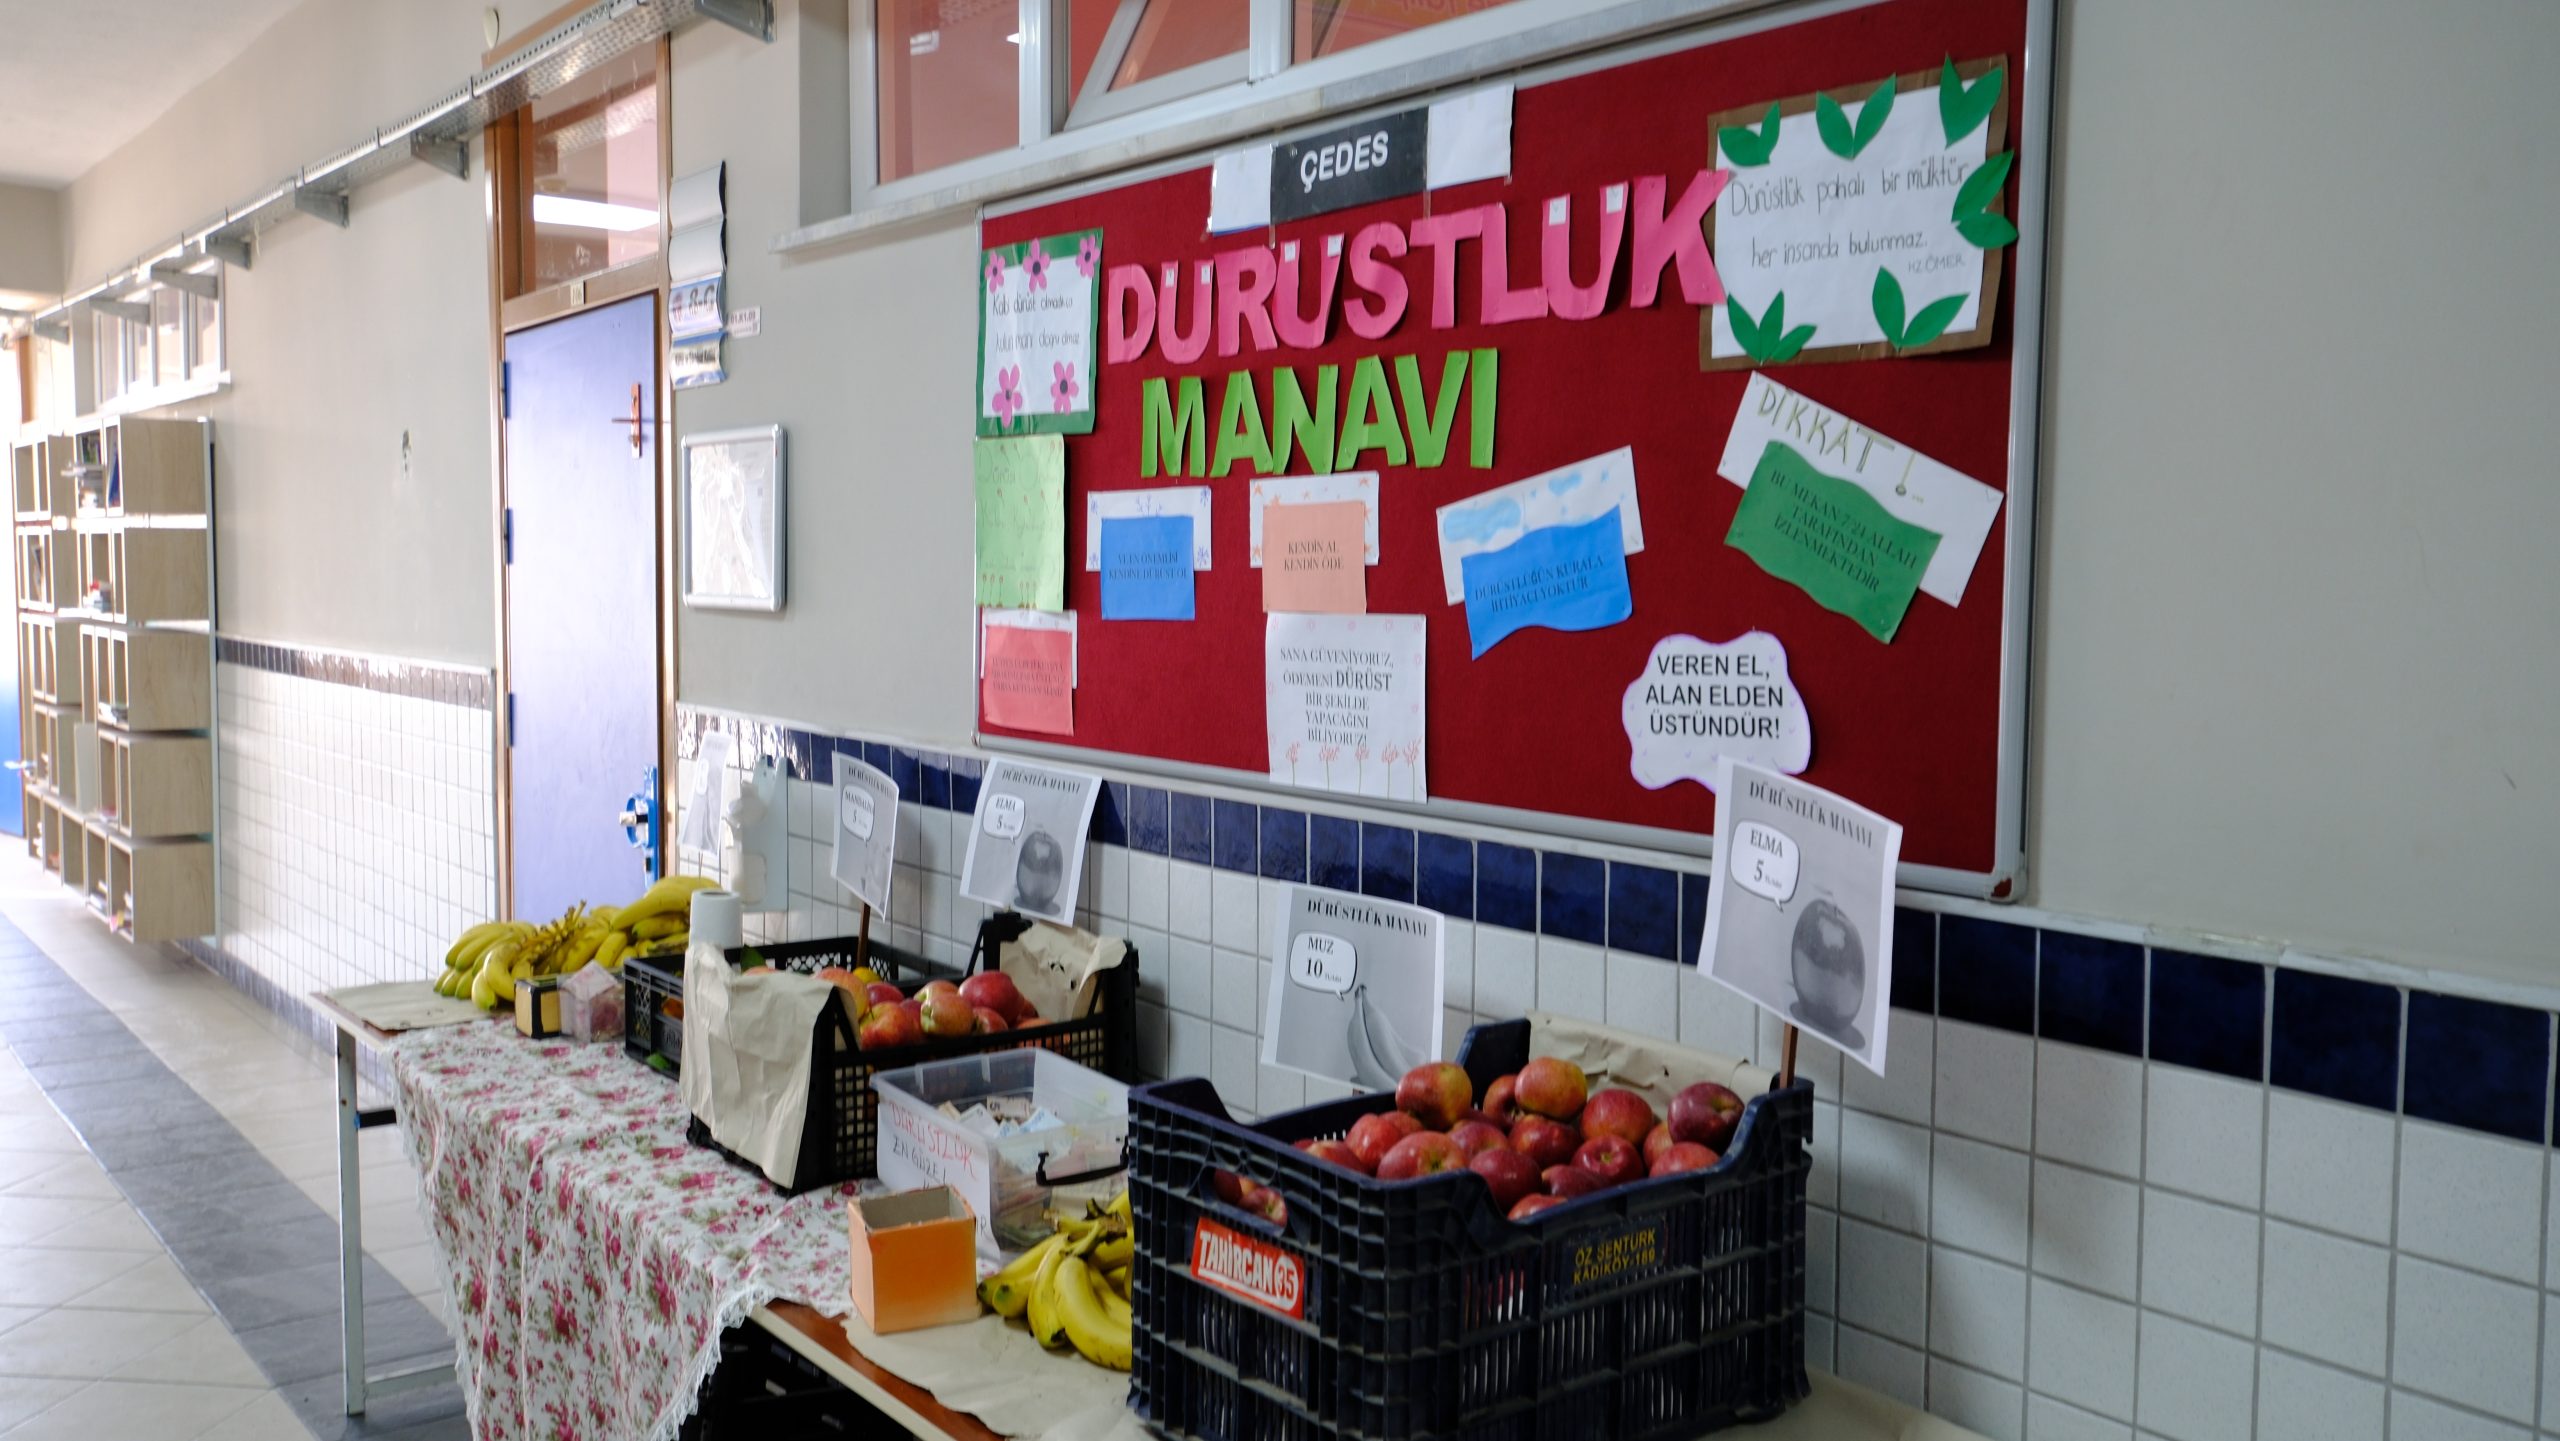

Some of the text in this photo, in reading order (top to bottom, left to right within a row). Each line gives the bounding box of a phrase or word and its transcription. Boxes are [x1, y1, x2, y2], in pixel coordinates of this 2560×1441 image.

[1301, 130, 1389, 194] ÇEDES
[1731, 153, 1970, 217] Dürüstlük pahalı bir mülktür
[1107, 168, 1729, 365] DÜRÜSTLÜK
[1751, 236, 1778, 269] her
[1784, 236, 1839, 265] insanda
[1141, 347, 1498, 478] MANAVI
[1792, 483, 1840, 521] MEKAN
[1871, 531, 1917, 569] ALLAH
[1792, 505, 1876, 568] TARAFINDAN
[1288, 540, 1322, 554] KENDİN
[1774, 513, 1880, 593] İZLENMEKTEDİR
[1284, 557, 1344, 571] KENDİN ÖDE
[1280, 648, 1307, 663] SANA
[1657, 653, 1770, 681] VEREN EL,
[1335, 667, 1392, 692] DÜRÜST
[1305, 691, 1322, 707] BİR
[1645, 684, 1783, 708] ALAN ELDEN
[1650, 709, 1781, 740] ÜSTÜNDÜR!
[996, 814, 1004, 830] 5
[1749, 780, 1873, 850] DÜRÜSTLÜK MANAVI
[1750, 829, 1783, 859] ELMA
[1753, 858, 1764, 883] 5
[1307, 898, 1428, 939] DÜRÜSTLÜK MANAVI
[1308, 936, 1334, 956] MUZ
[1305, 957, 1323, 979] 10
[1200, 1230, 1274, 1297] TAHİRCAN
